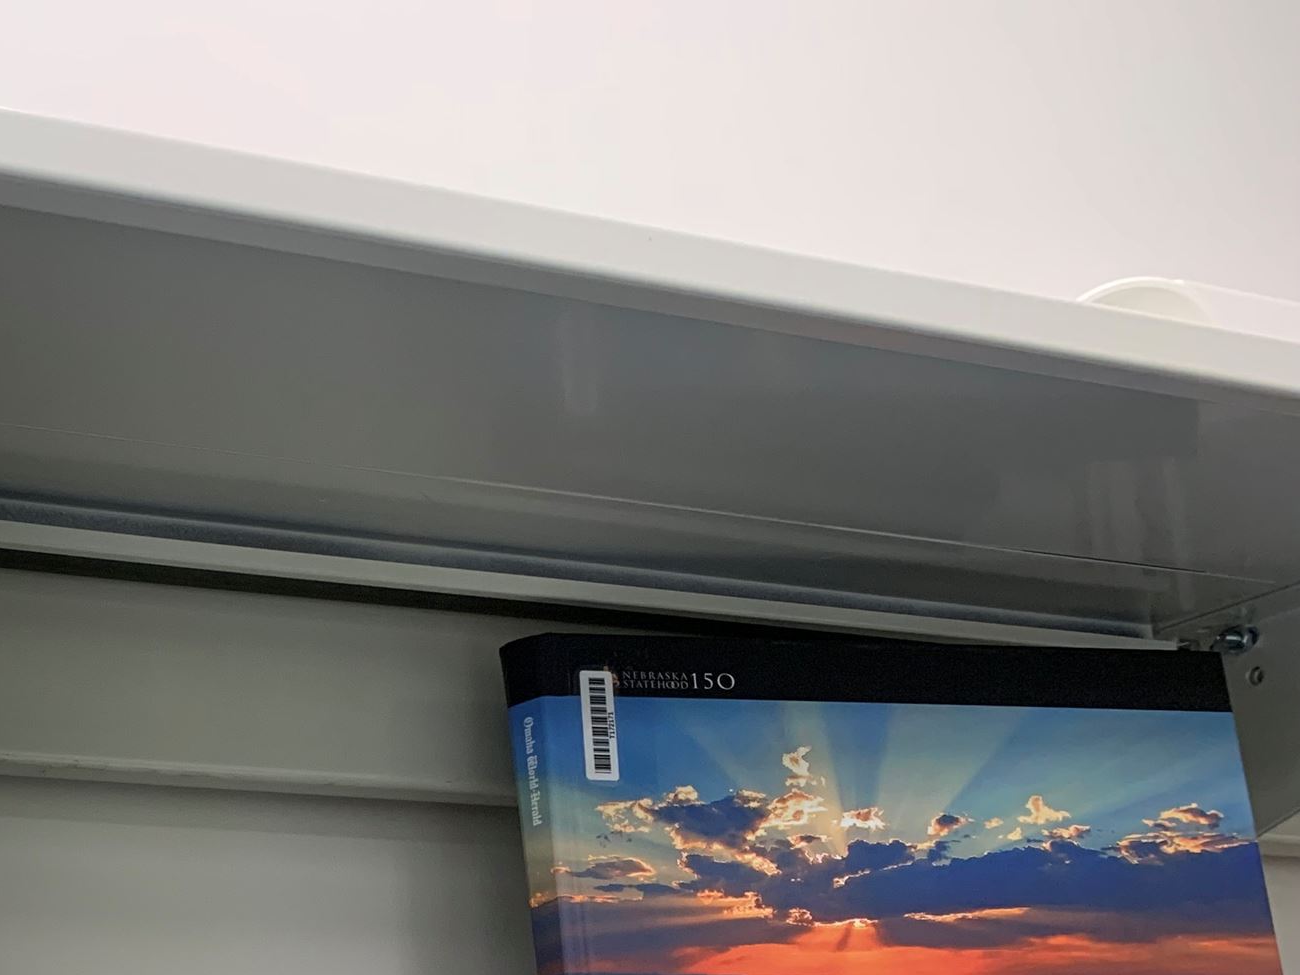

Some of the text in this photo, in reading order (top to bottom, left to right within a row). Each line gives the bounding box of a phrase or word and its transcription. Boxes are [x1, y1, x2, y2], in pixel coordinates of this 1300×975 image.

[622, 671, 688, 680] NEBRASKA
[690, 672, 736, 690] 150
[623, 680, 690, 690] STATEHOOD
[524, 716, 536, 754] Omaha
